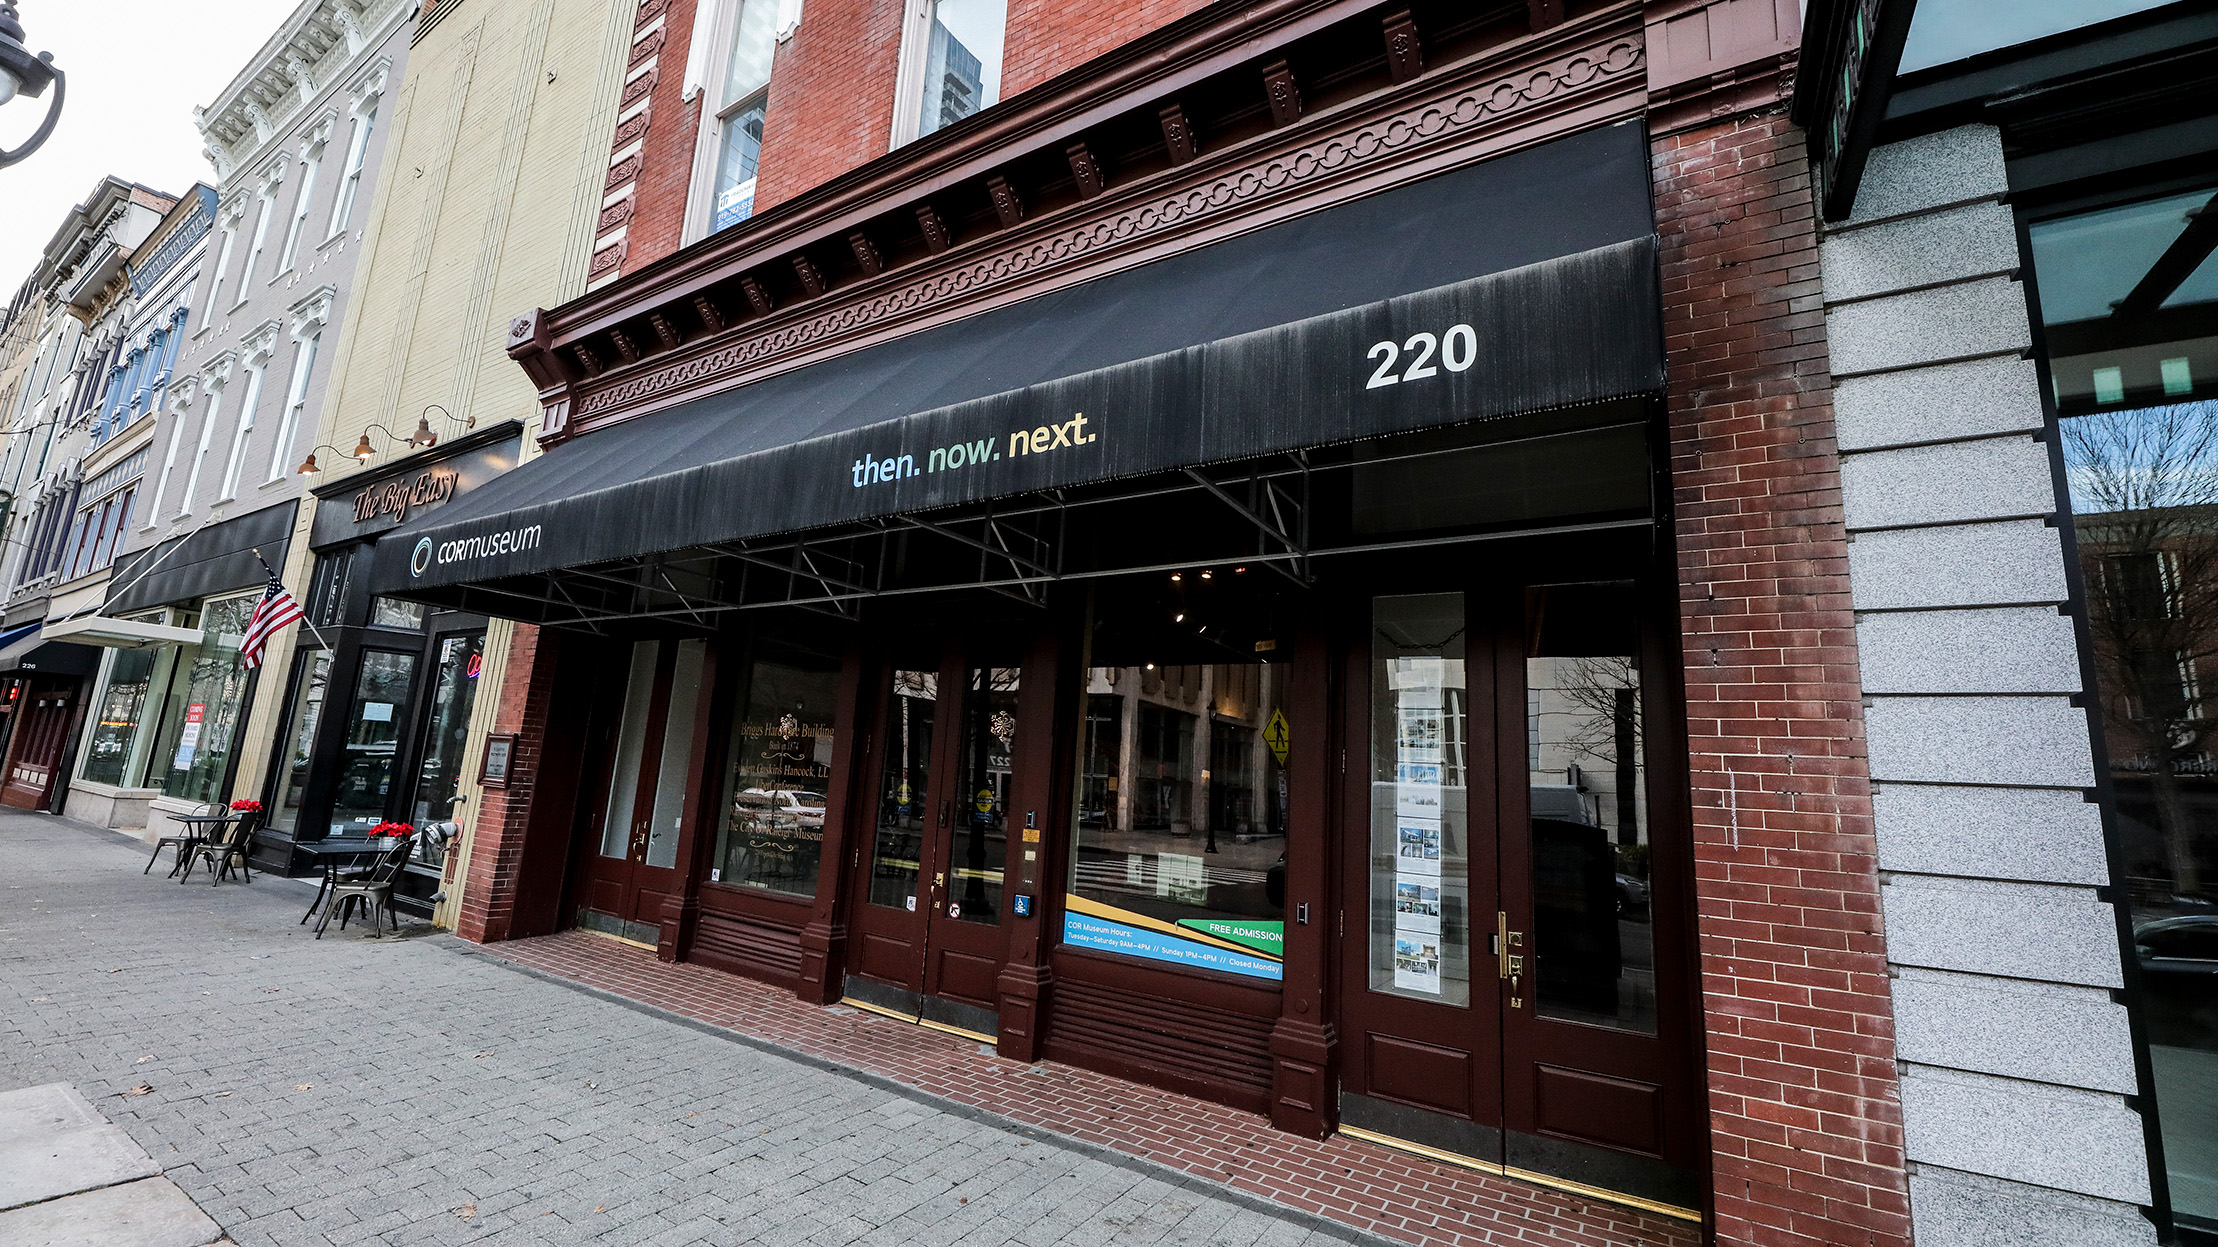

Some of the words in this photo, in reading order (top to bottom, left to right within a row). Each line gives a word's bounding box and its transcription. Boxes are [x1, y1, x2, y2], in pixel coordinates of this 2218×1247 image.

[1365, 323, 1478, 390] 220
[851, 452, 921, 488] then.
[928, 437, 1000, 473] now.
[1008, 412, 1096, 458] next.
[352, 484, 380, 523] The
[381, 478, 412, 523] Big
[411, 472, 460, 506] Easy
[22, 662, 37, 670] 226
[740, 721, 764, 740] Briggs
[801, 723, 836, 742] Building
[1067, 920, 1082, 930] COR
[1082, 923, 1110, 935] Museum
[1110, 927, 1133, 938] Hours:
[1209, 923, 1231, 934] FREE
[1232, 927, 1283, 942] ADMISSION
[1161, 946, 1184, 958] Sunday
[1228, 958, 1252, 969] Closed
[1252, 962, 1280, 974] Monday
